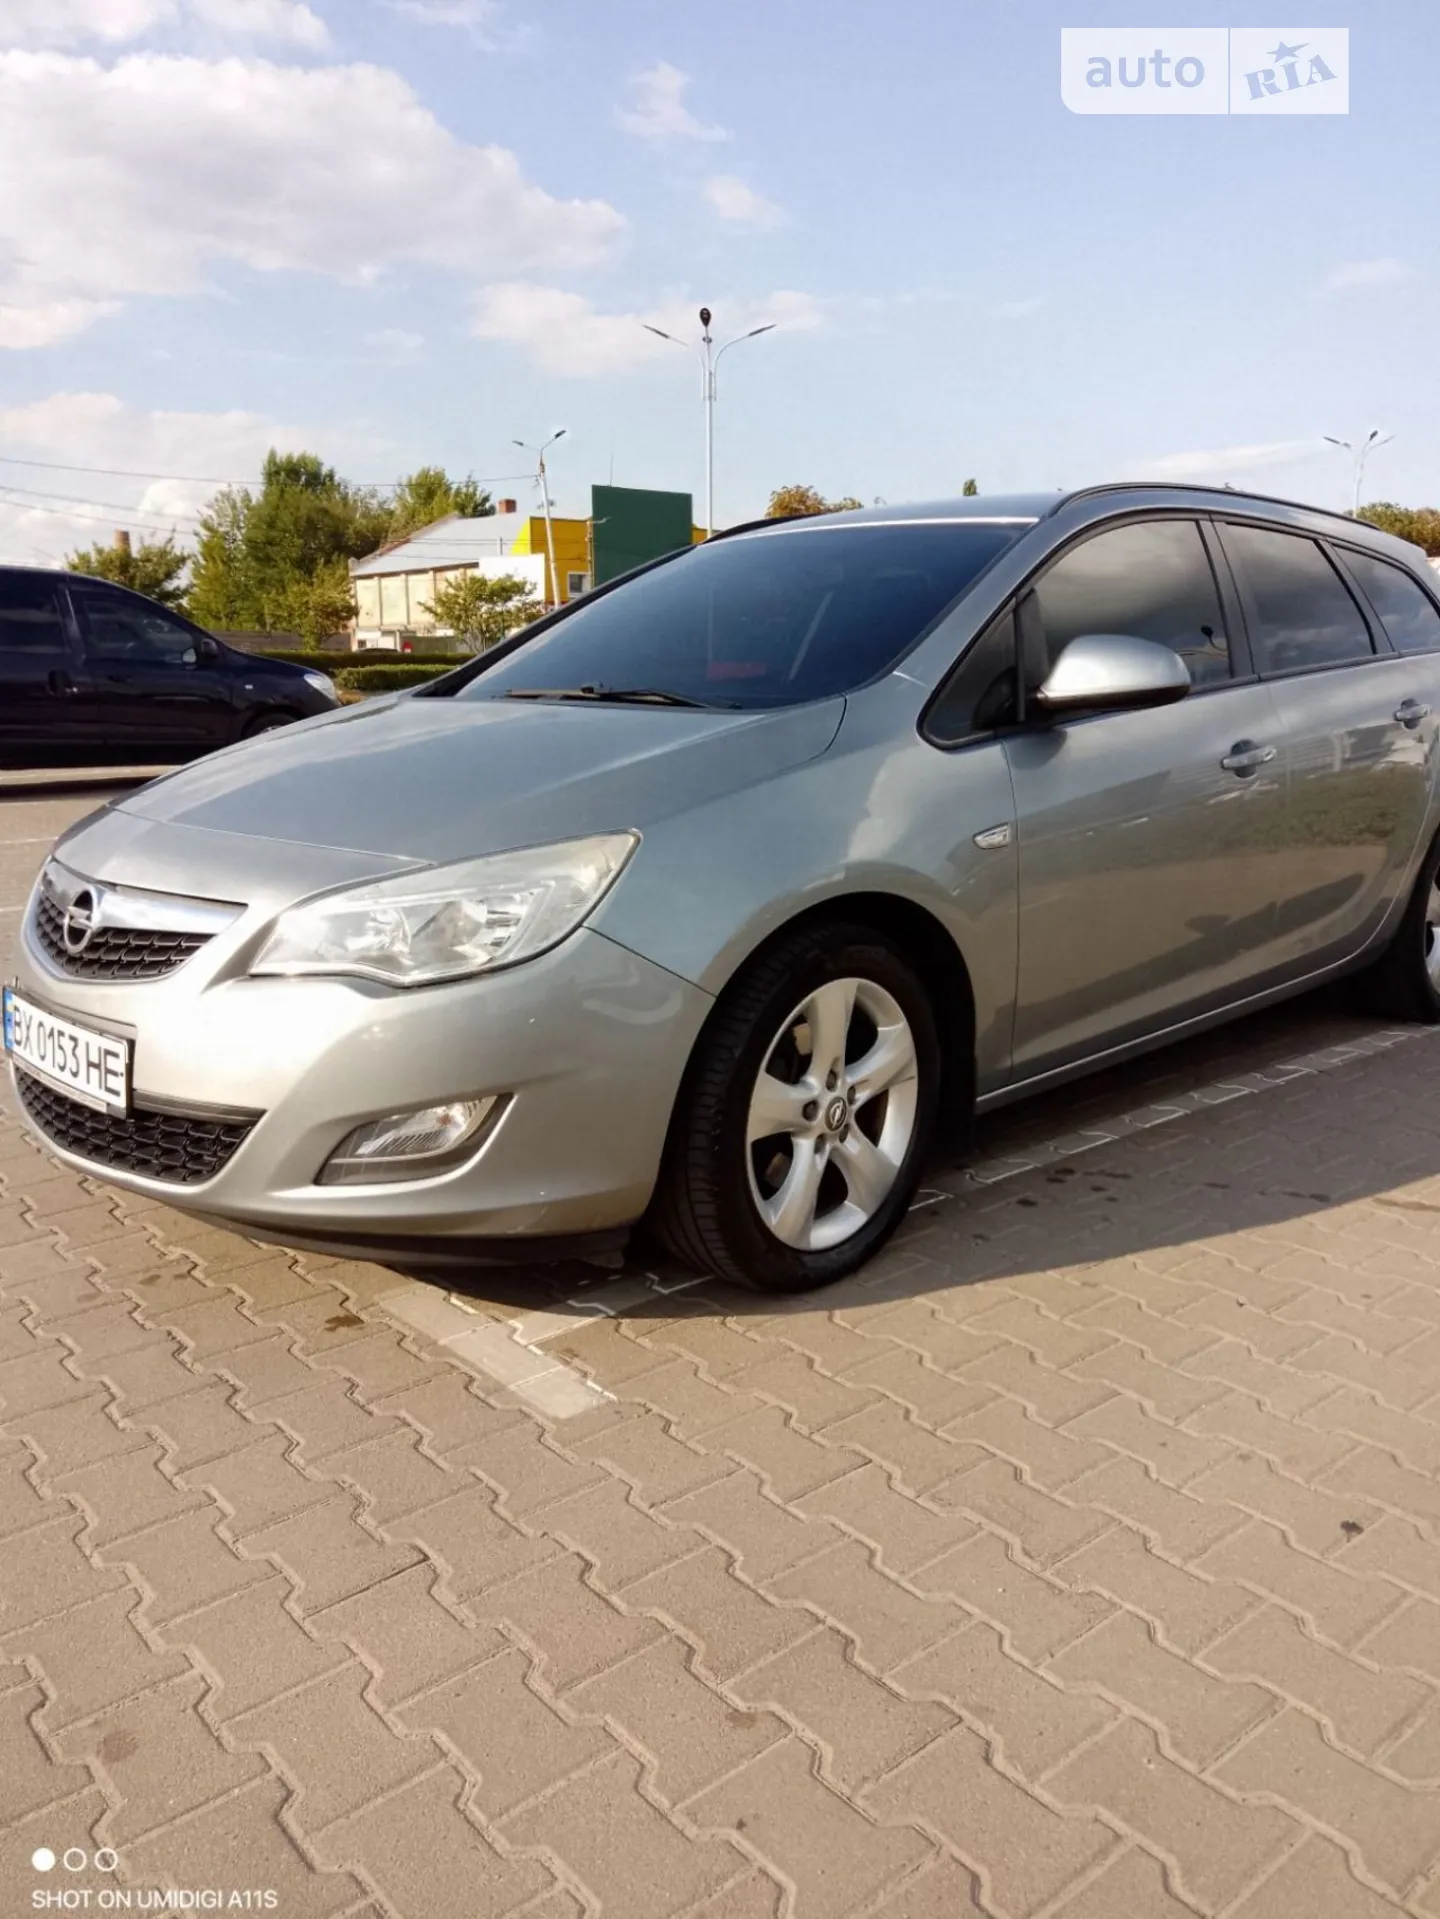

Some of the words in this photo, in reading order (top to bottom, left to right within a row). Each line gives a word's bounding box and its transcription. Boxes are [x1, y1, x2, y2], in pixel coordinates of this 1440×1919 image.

[13, 1004, 33, 1056] BX
[37, 1020, 80, 1078] 0153
[85, 1041, 121, 1097] HE
